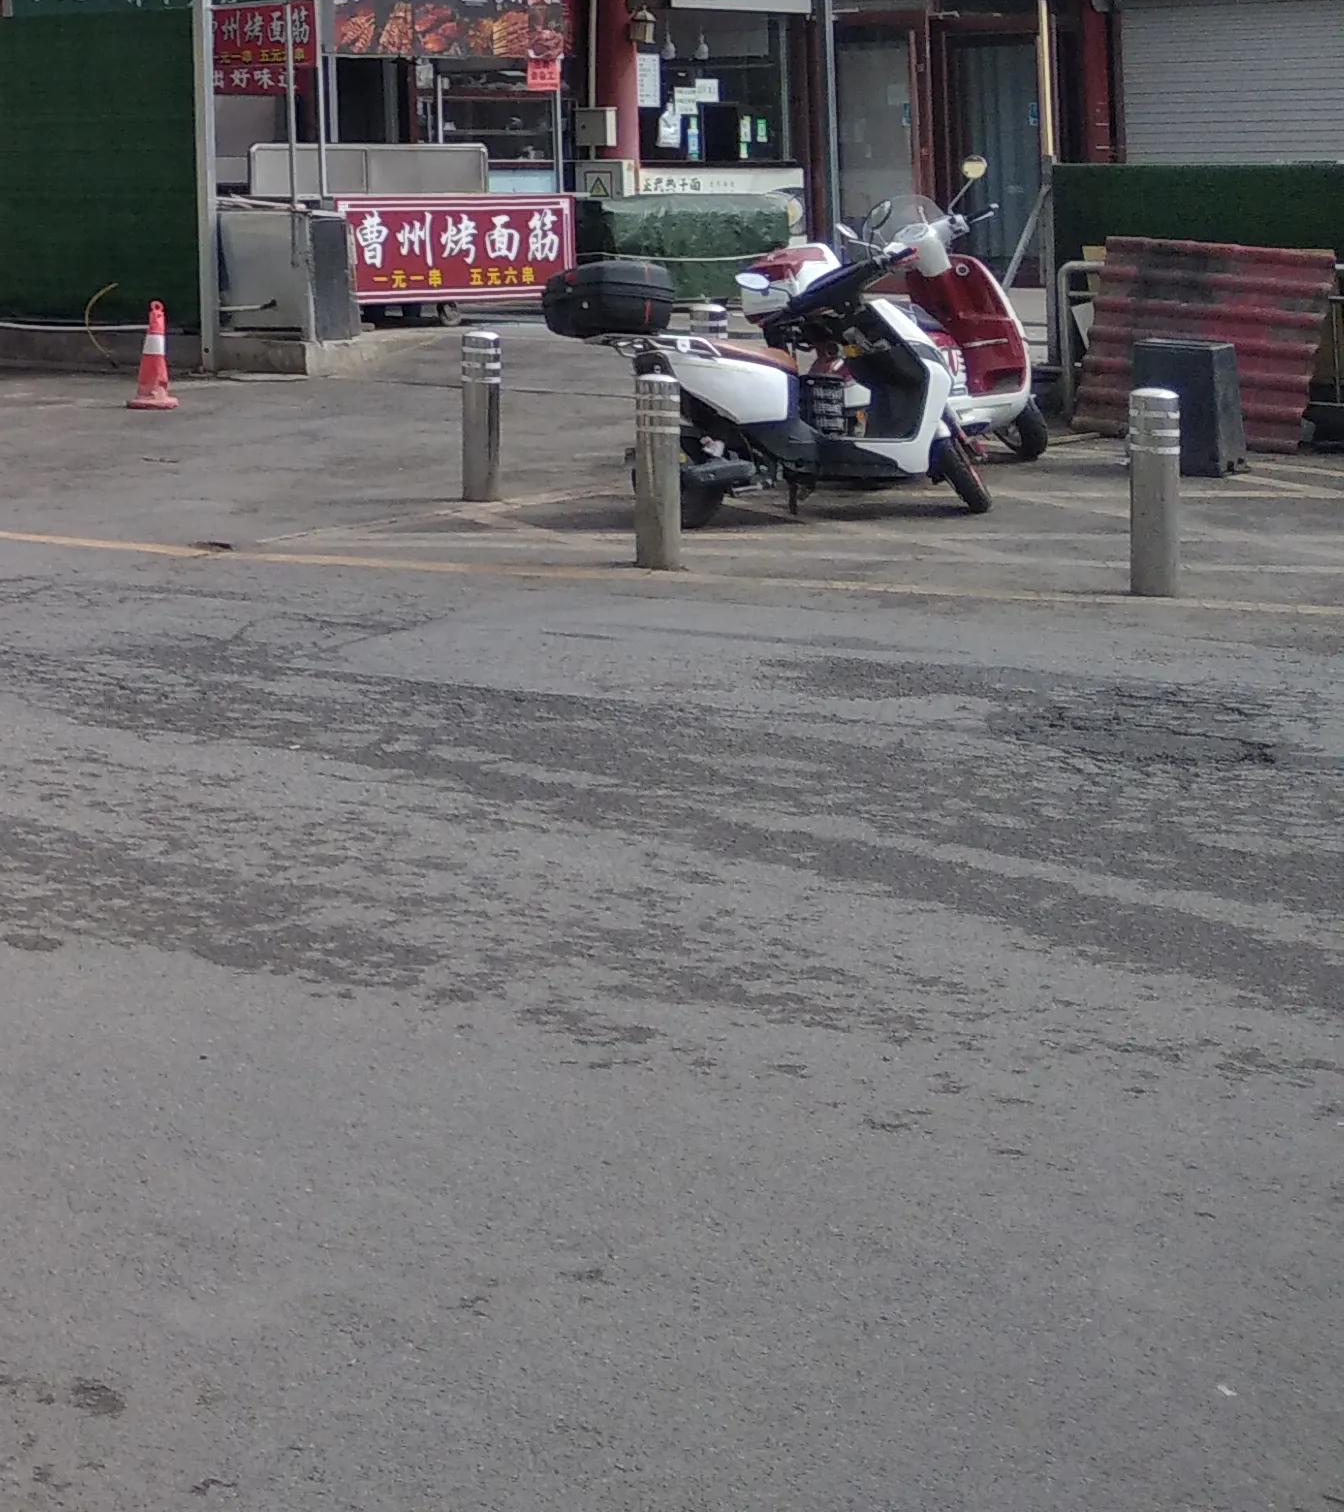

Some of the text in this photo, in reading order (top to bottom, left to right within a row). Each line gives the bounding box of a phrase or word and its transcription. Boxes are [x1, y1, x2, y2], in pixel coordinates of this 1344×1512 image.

[213, 5, 310, 47] 州烤面筋
[356, 208, 559, 268] 曹州烤面筋
[373, 266, 535, 288] 一元一串 五元六串
